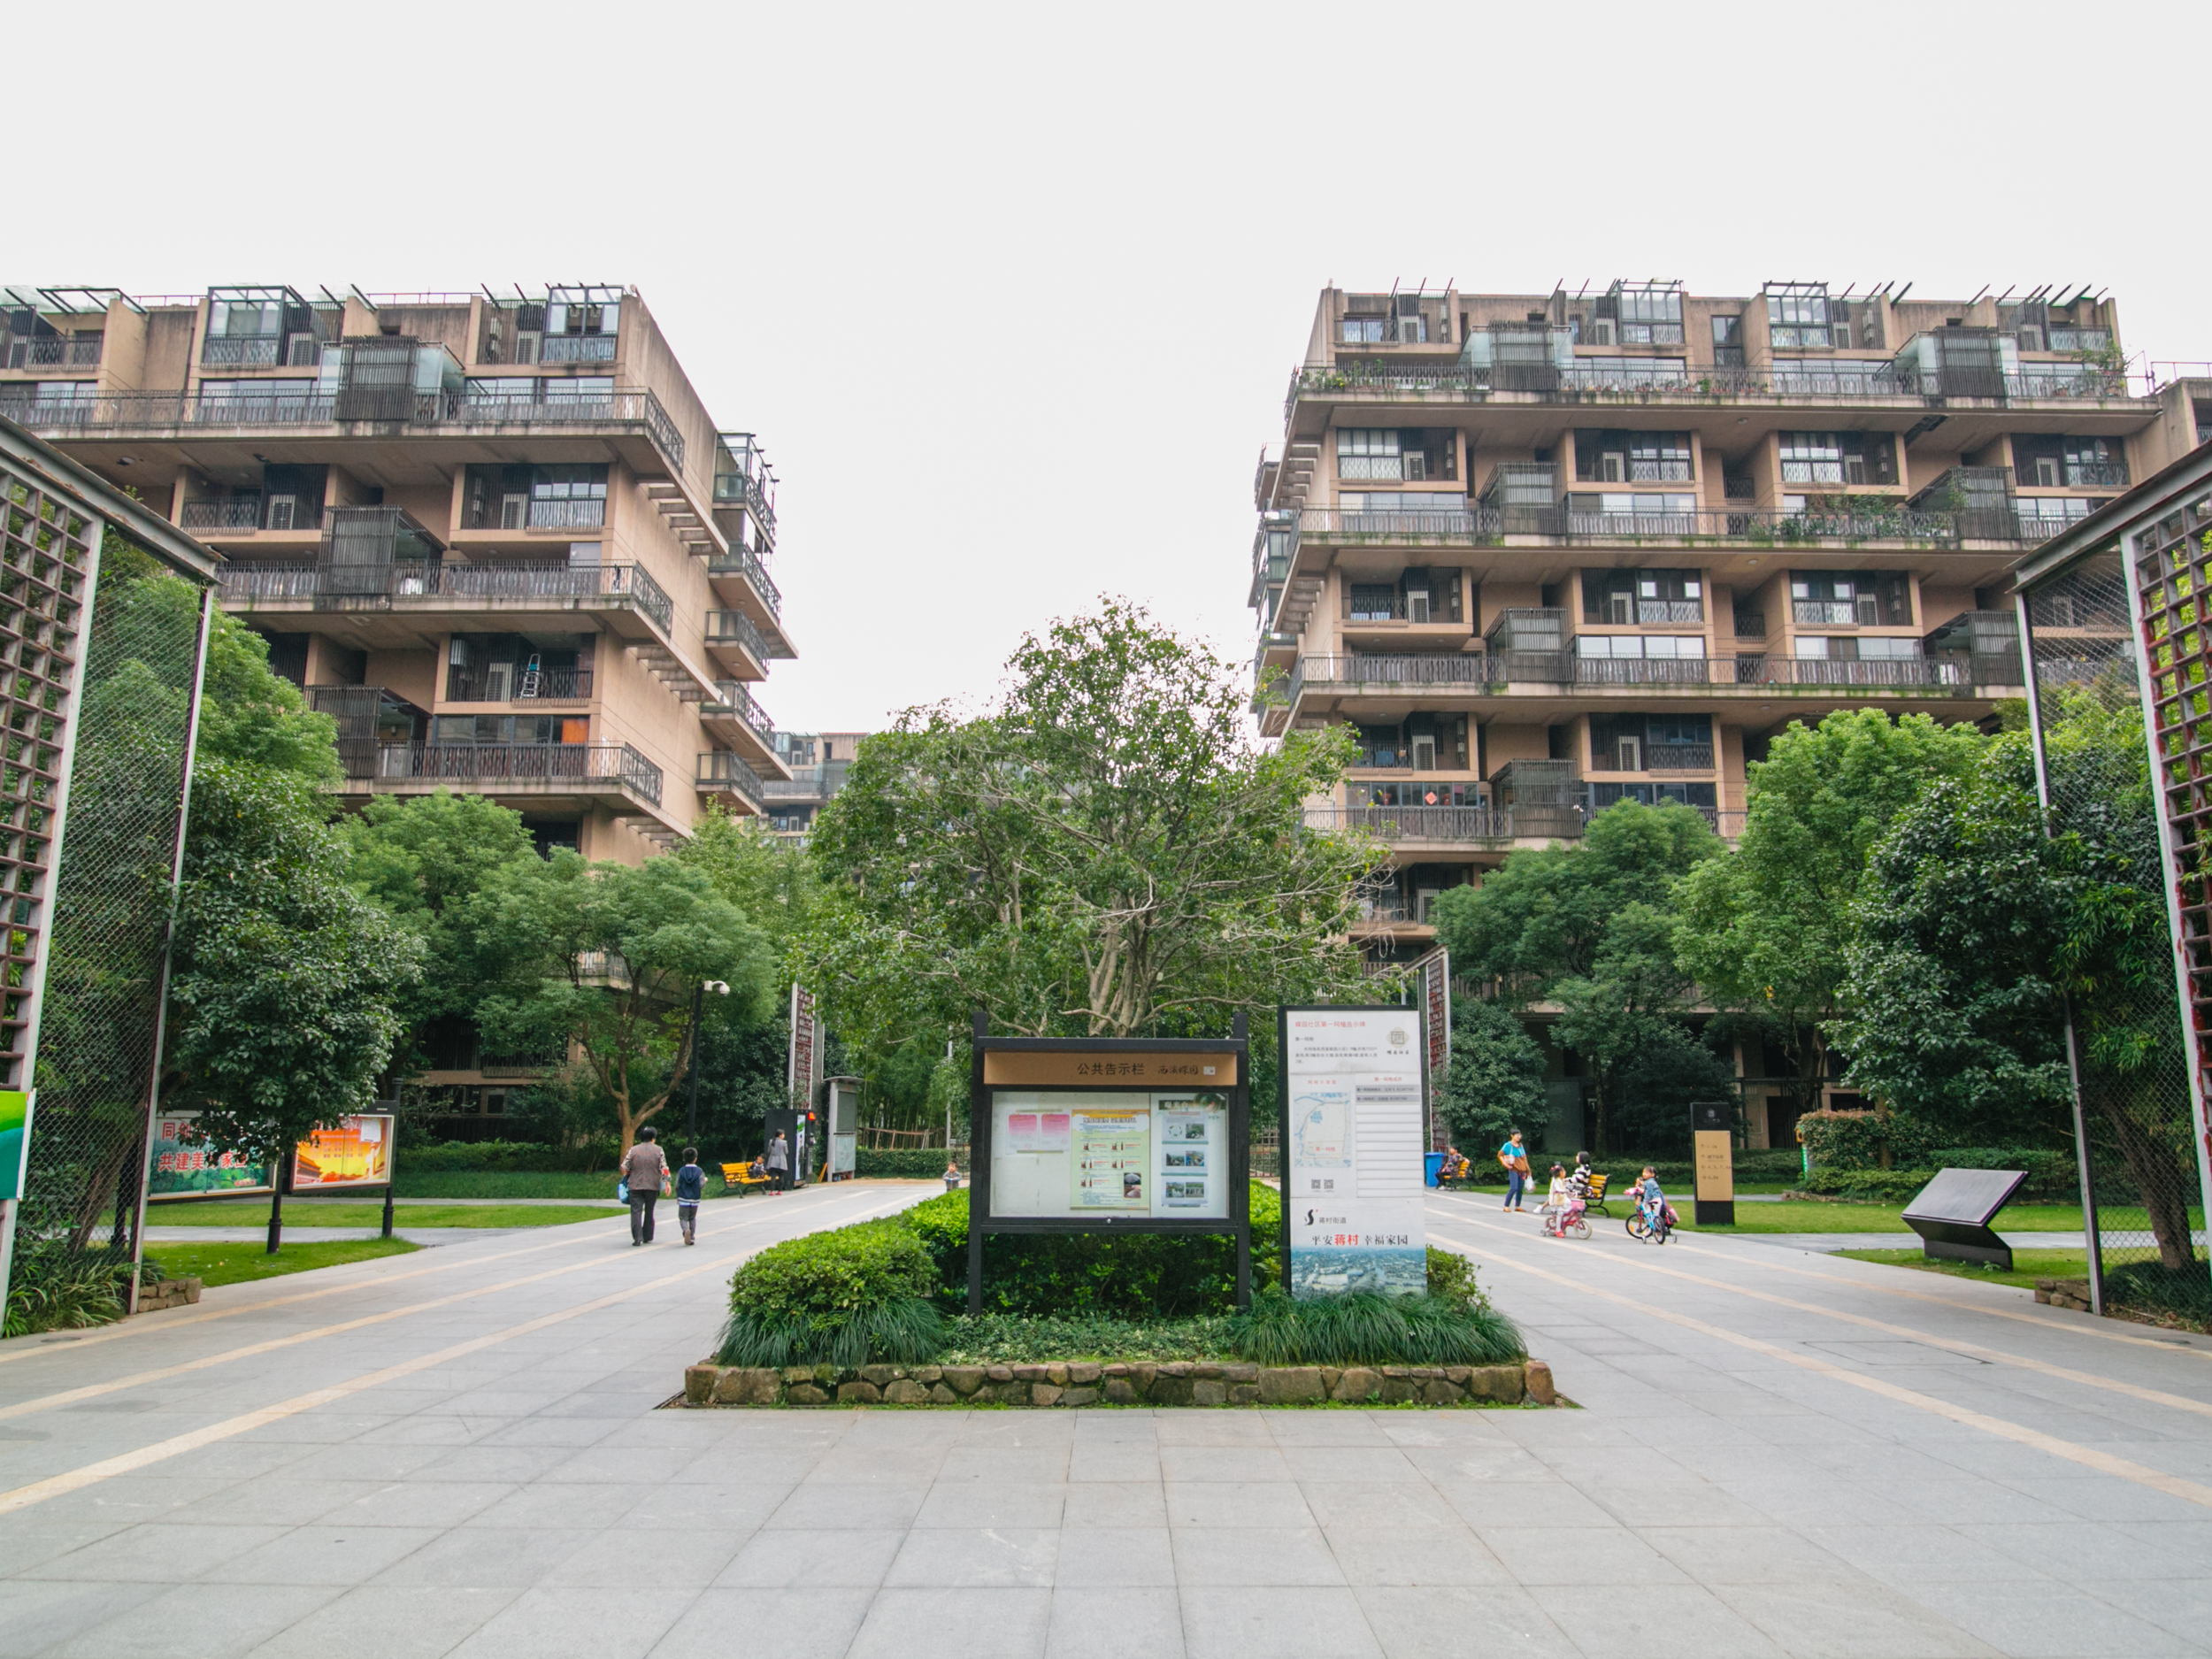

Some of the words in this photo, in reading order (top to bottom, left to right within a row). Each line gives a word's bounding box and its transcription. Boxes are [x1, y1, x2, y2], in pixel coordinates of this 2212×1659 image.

[1077, 1063, 1145, 1076] 公共告示栏
[1311, 1233, 1359, 1247] 平安蒋村
[1363, 1233, 1409, 1247] 幸福家园
